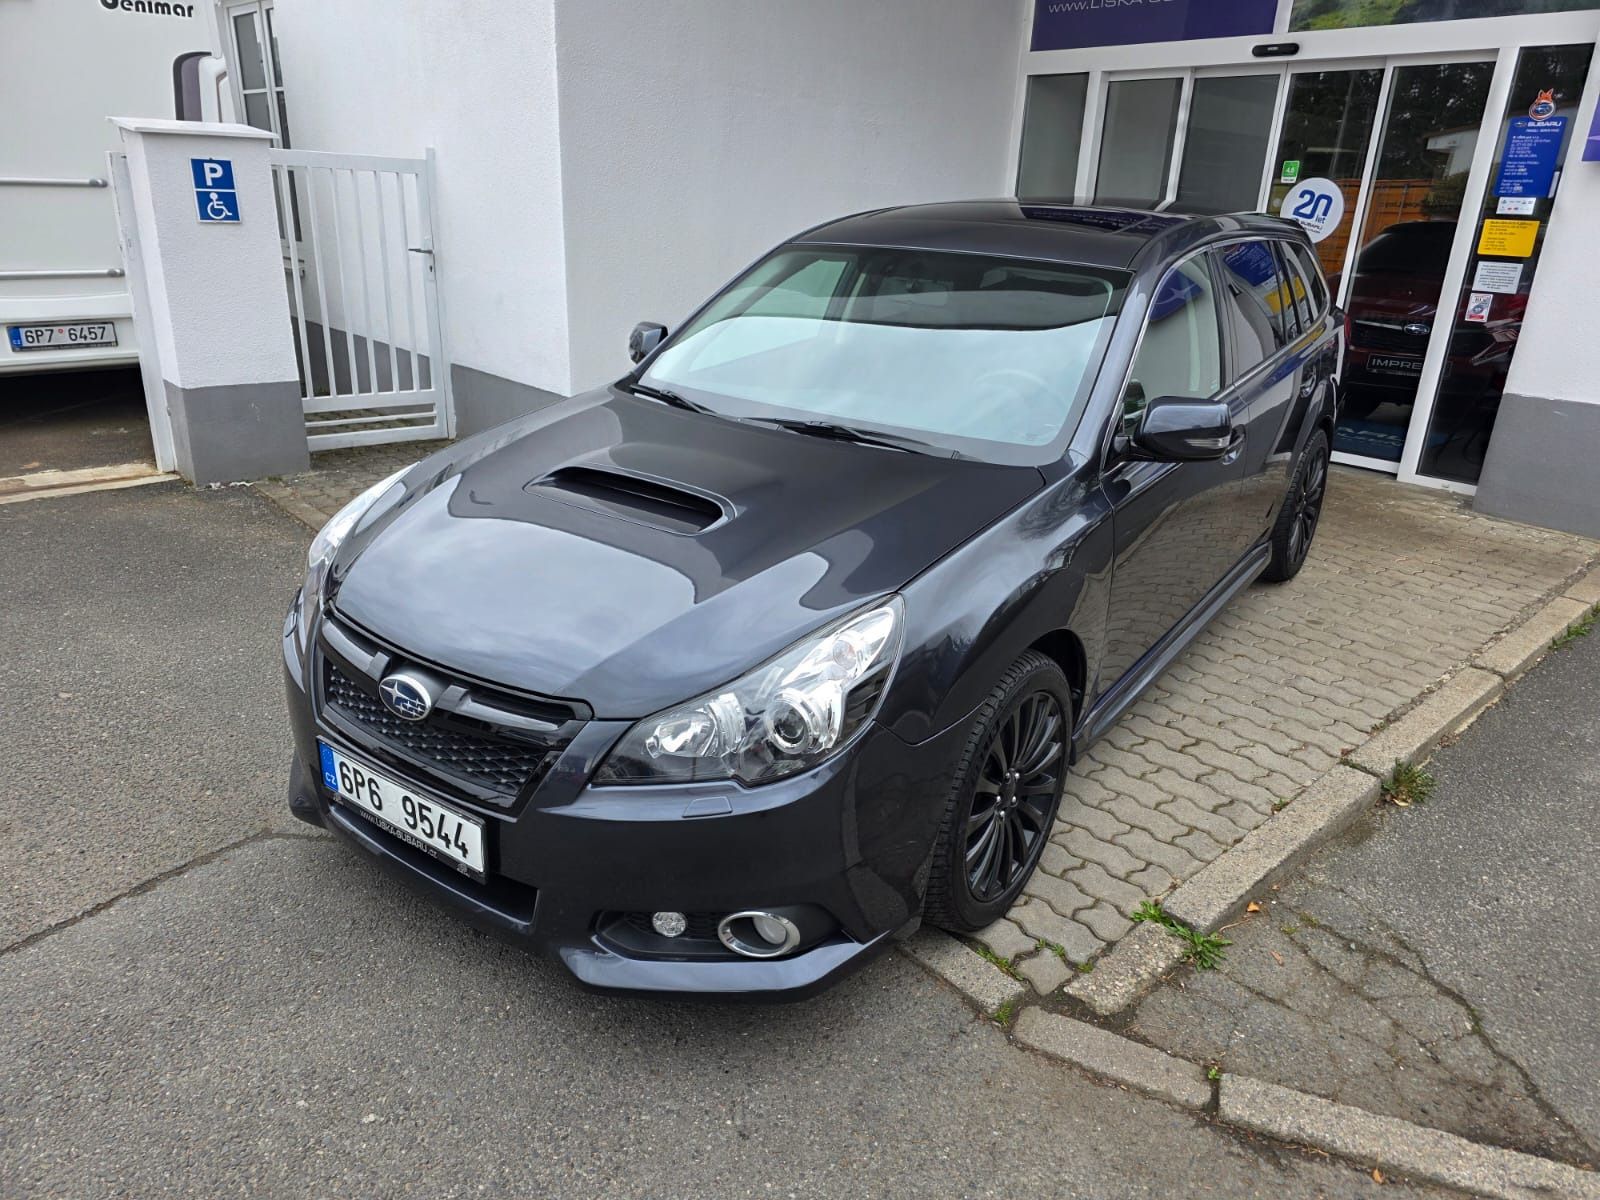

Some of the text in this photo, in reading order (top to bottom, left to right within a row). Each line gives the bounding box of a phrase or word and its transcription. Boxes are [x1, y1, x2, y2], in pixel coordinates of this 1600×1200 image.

[203, 162, 223, 186] P
[1292, 189, 1333, 220] 20
[24, 326, 106, 344] 6P7 6457
[1371, 358, 1423, 370] IMPRE
[325, 772, 337, 786] CZ
[339, 760, 469, 860] 6P6 9544
